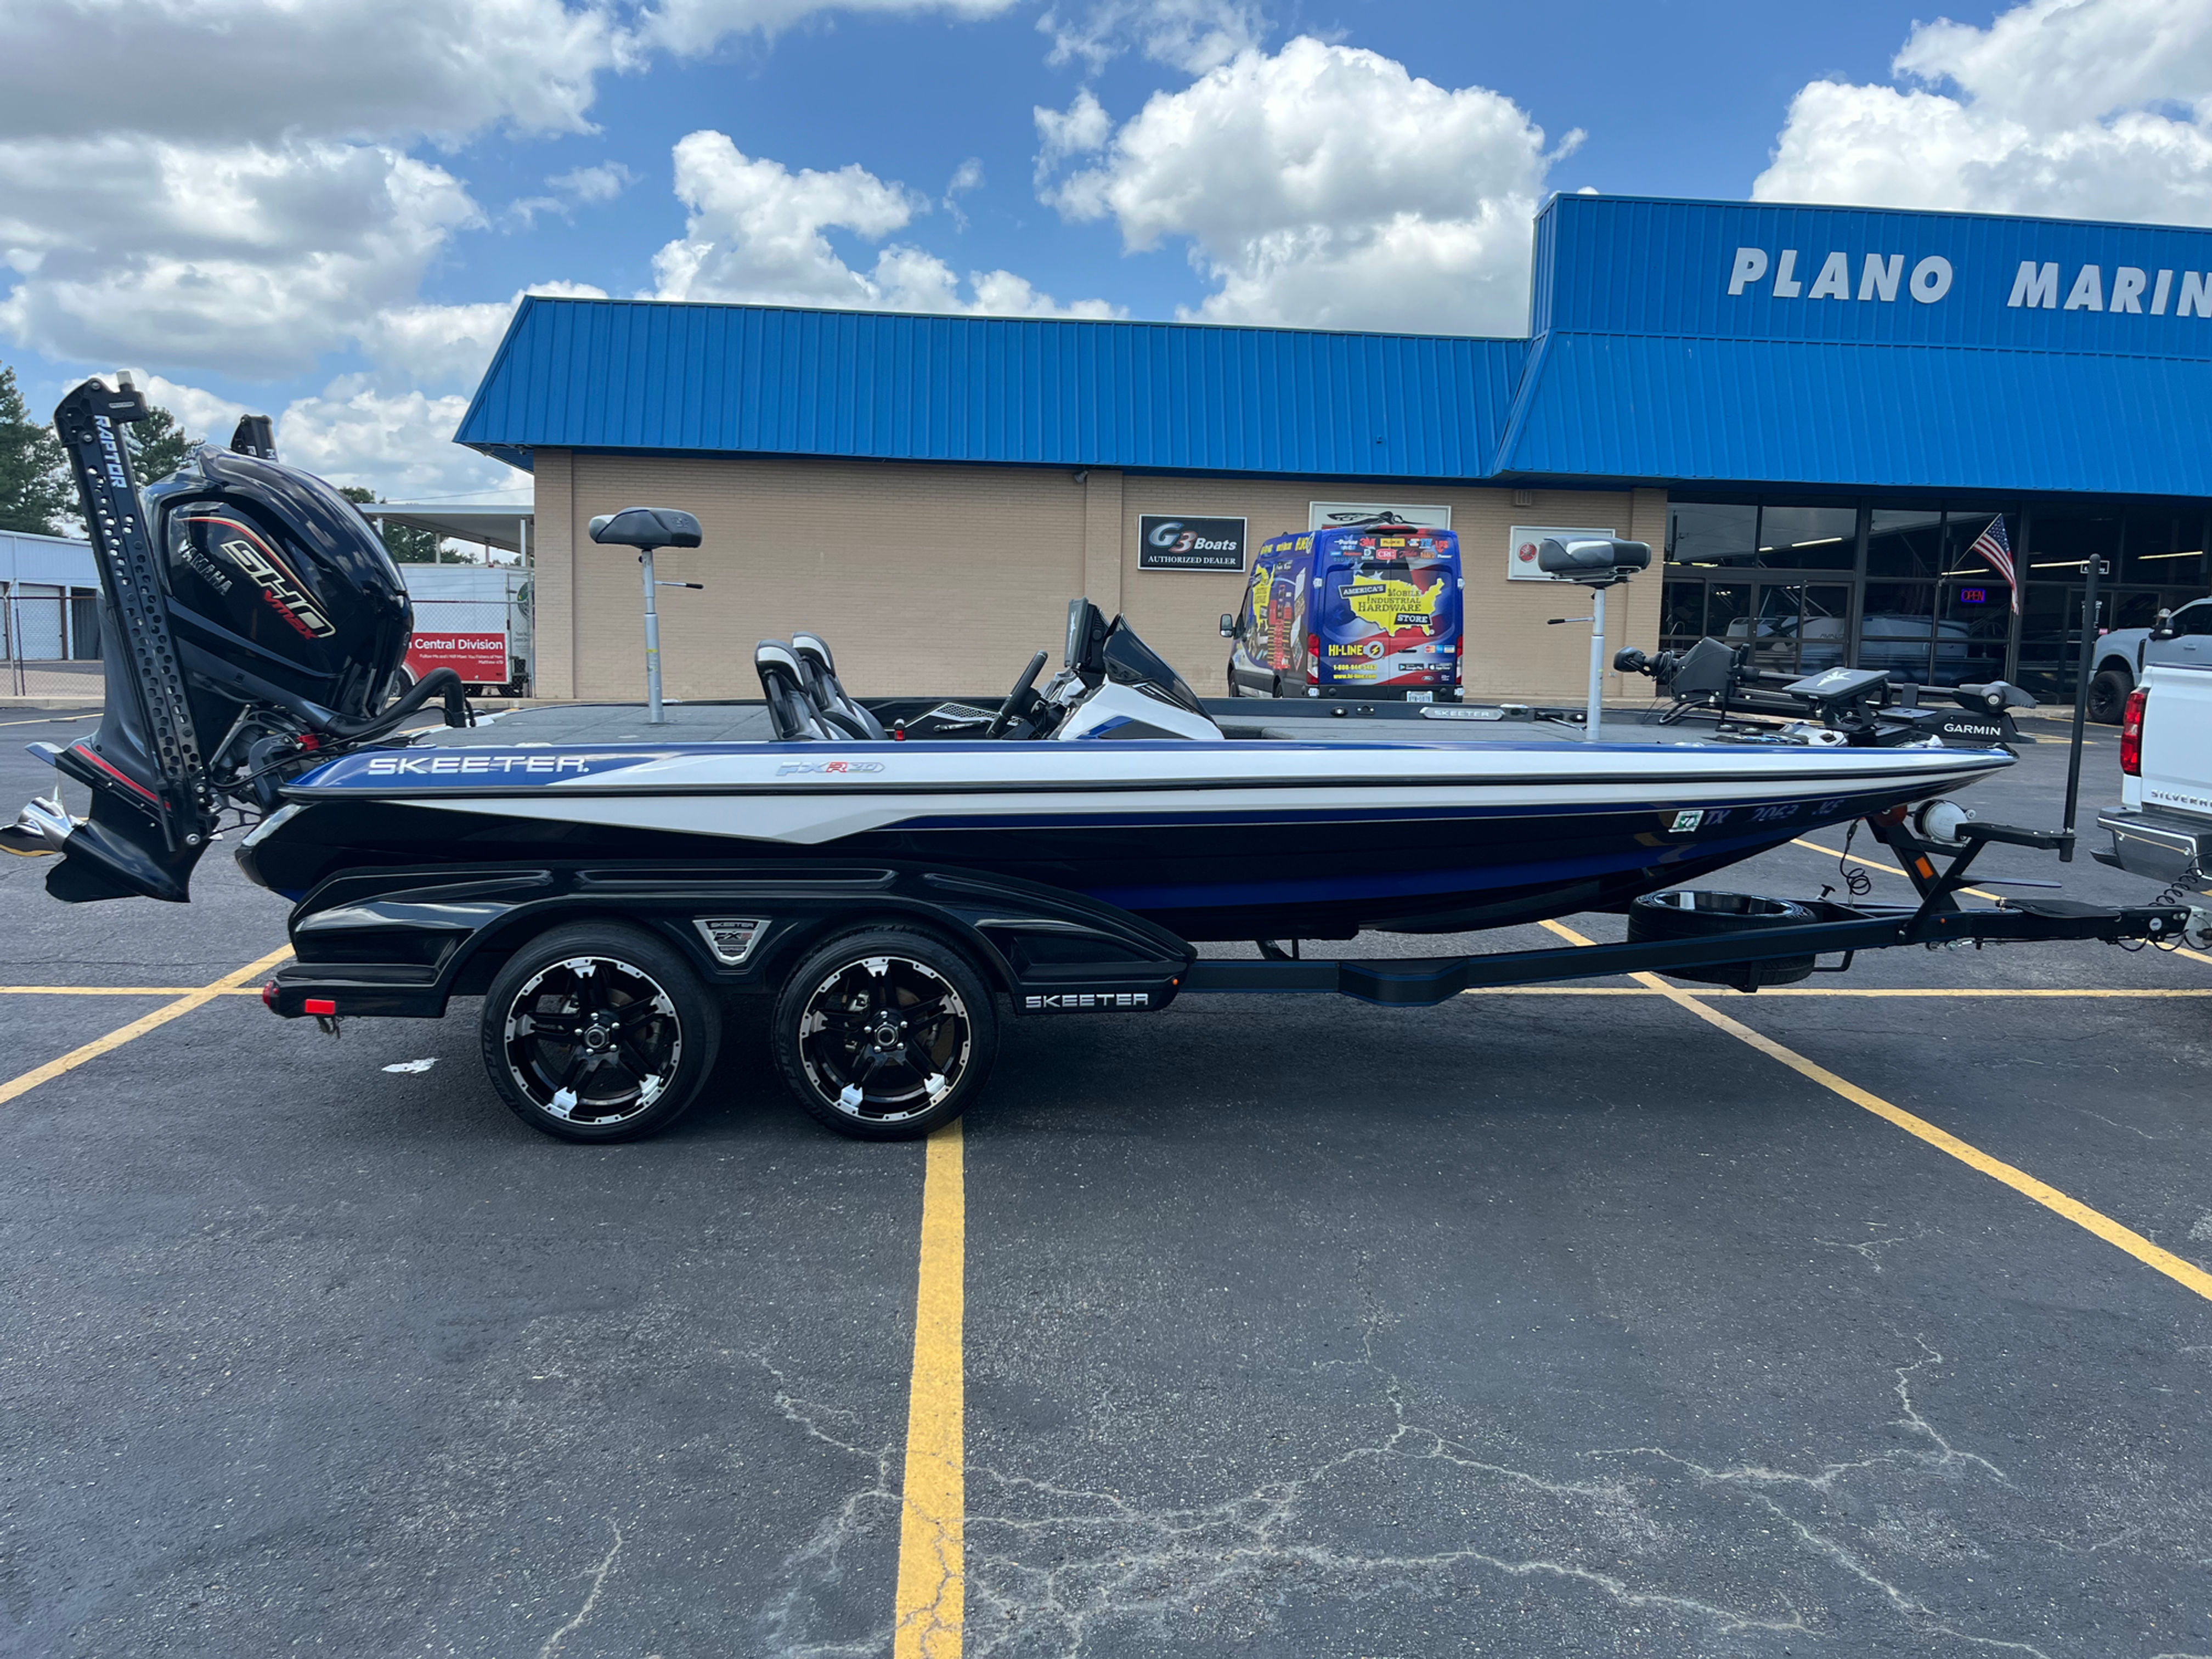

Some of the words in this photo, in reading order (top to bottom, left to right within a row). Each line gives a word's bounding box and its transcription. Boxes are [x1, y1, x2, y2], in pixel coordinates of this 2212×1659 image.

[1728, 247, 1953, 303] PLANO
[2007, 261, 2212, 318] MARIN
[94, 414, 128, 488] RAPTOR
[1148, 522, 1198, 554] G3
[1194, 538, 1237, 551] Boats
[1359, 538, 1376, 547] 3M
[1148, 556, 1201, 564] AUTHORIZED
[178, 539, 233, 596] YAMAHA
[221, 540, 336, 638] SHO
[1343, 585, 1384, 595] AMERICA'S
[1963, 590, 1983, 601] OPEN
[1358, 602, 1421, 612] HARDWARE
[1397, 614, 1428, 623] STORE
[415, 639, 455, 650] Central
[458, 639, 503, 650] Division
[1328, 644, 1364, 656] HI-LINE
[1944, 723, 2001, 736] GARMIN
[368, 756, 586, 775] SKEETER
[2151, 789, 2212, 808] SILVERA
[1703, 809, 1732, 825] TX
[713, 931, 753, 941] FXR
[1025, 993, 1149, 1008] SKEETER
